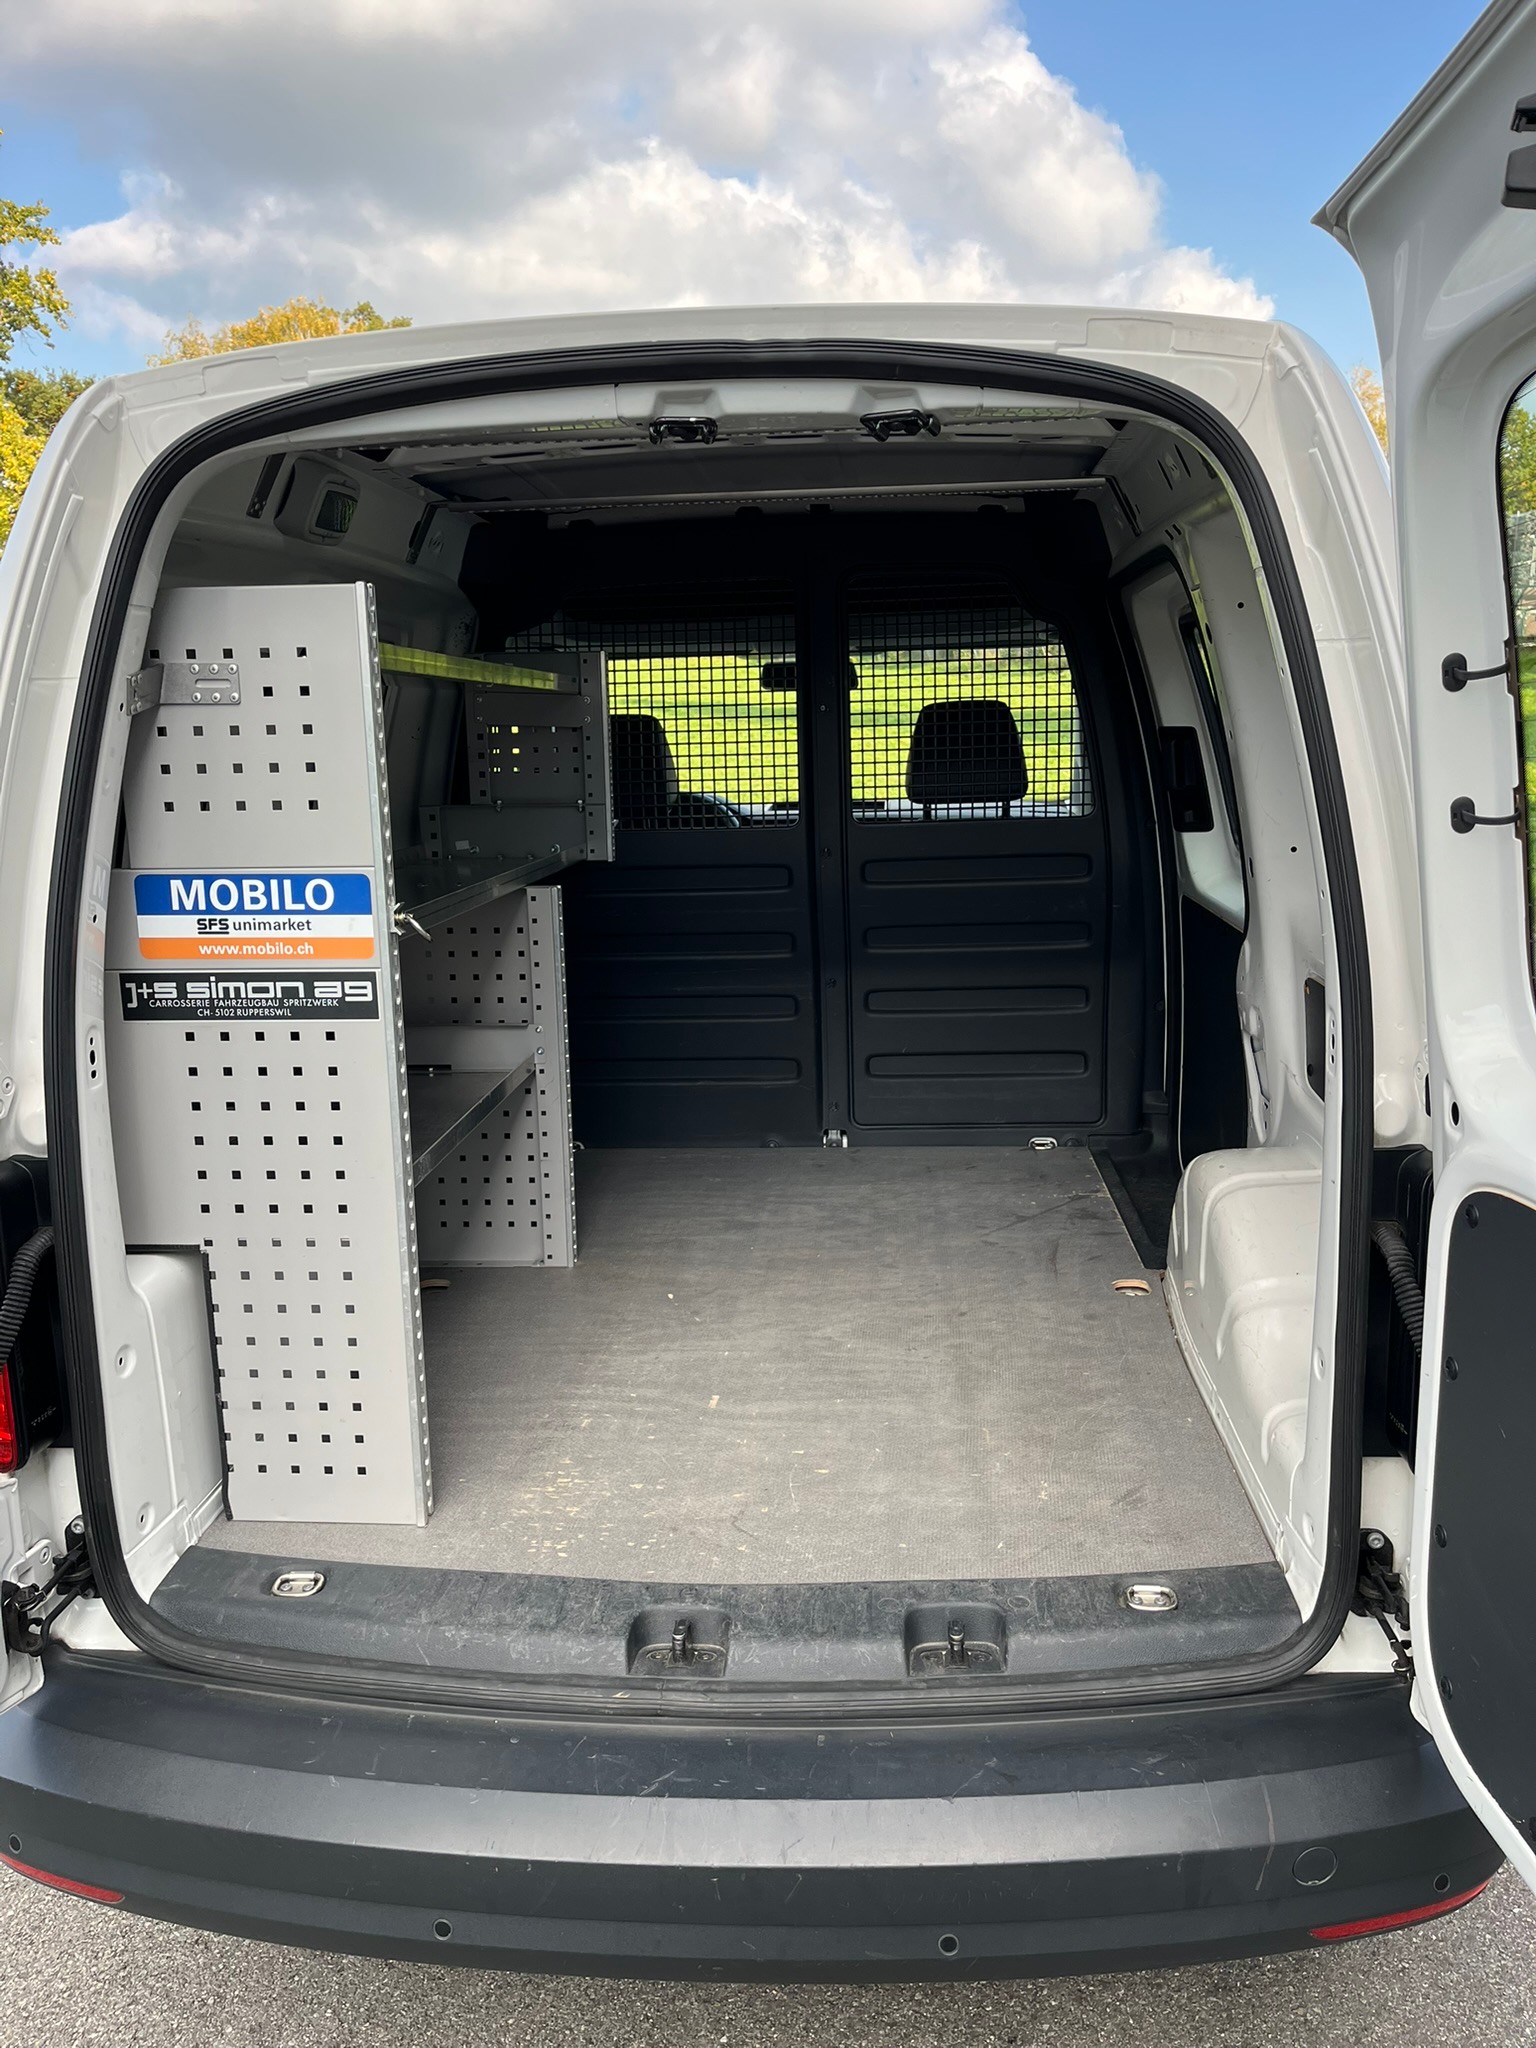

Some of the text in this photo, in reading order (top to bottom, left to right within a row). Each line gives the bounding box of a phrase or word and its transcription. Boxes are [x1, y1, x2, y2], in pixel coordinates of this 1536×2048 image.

[169, 878, 335, 912] MOBILO
[196, 918, 313, 933] SFS unimarket
[198, 942, 314, 955] www.mobilo.ch
[186, 976, 305, 999] simon
[313, 981, 373, 1002] ag
[149, 998, 339, 1008] CARROSSERIE FAHRZEUGBAU SPRITZWERK
[236, 1008, 292, 1017] RUPPERSWIL
